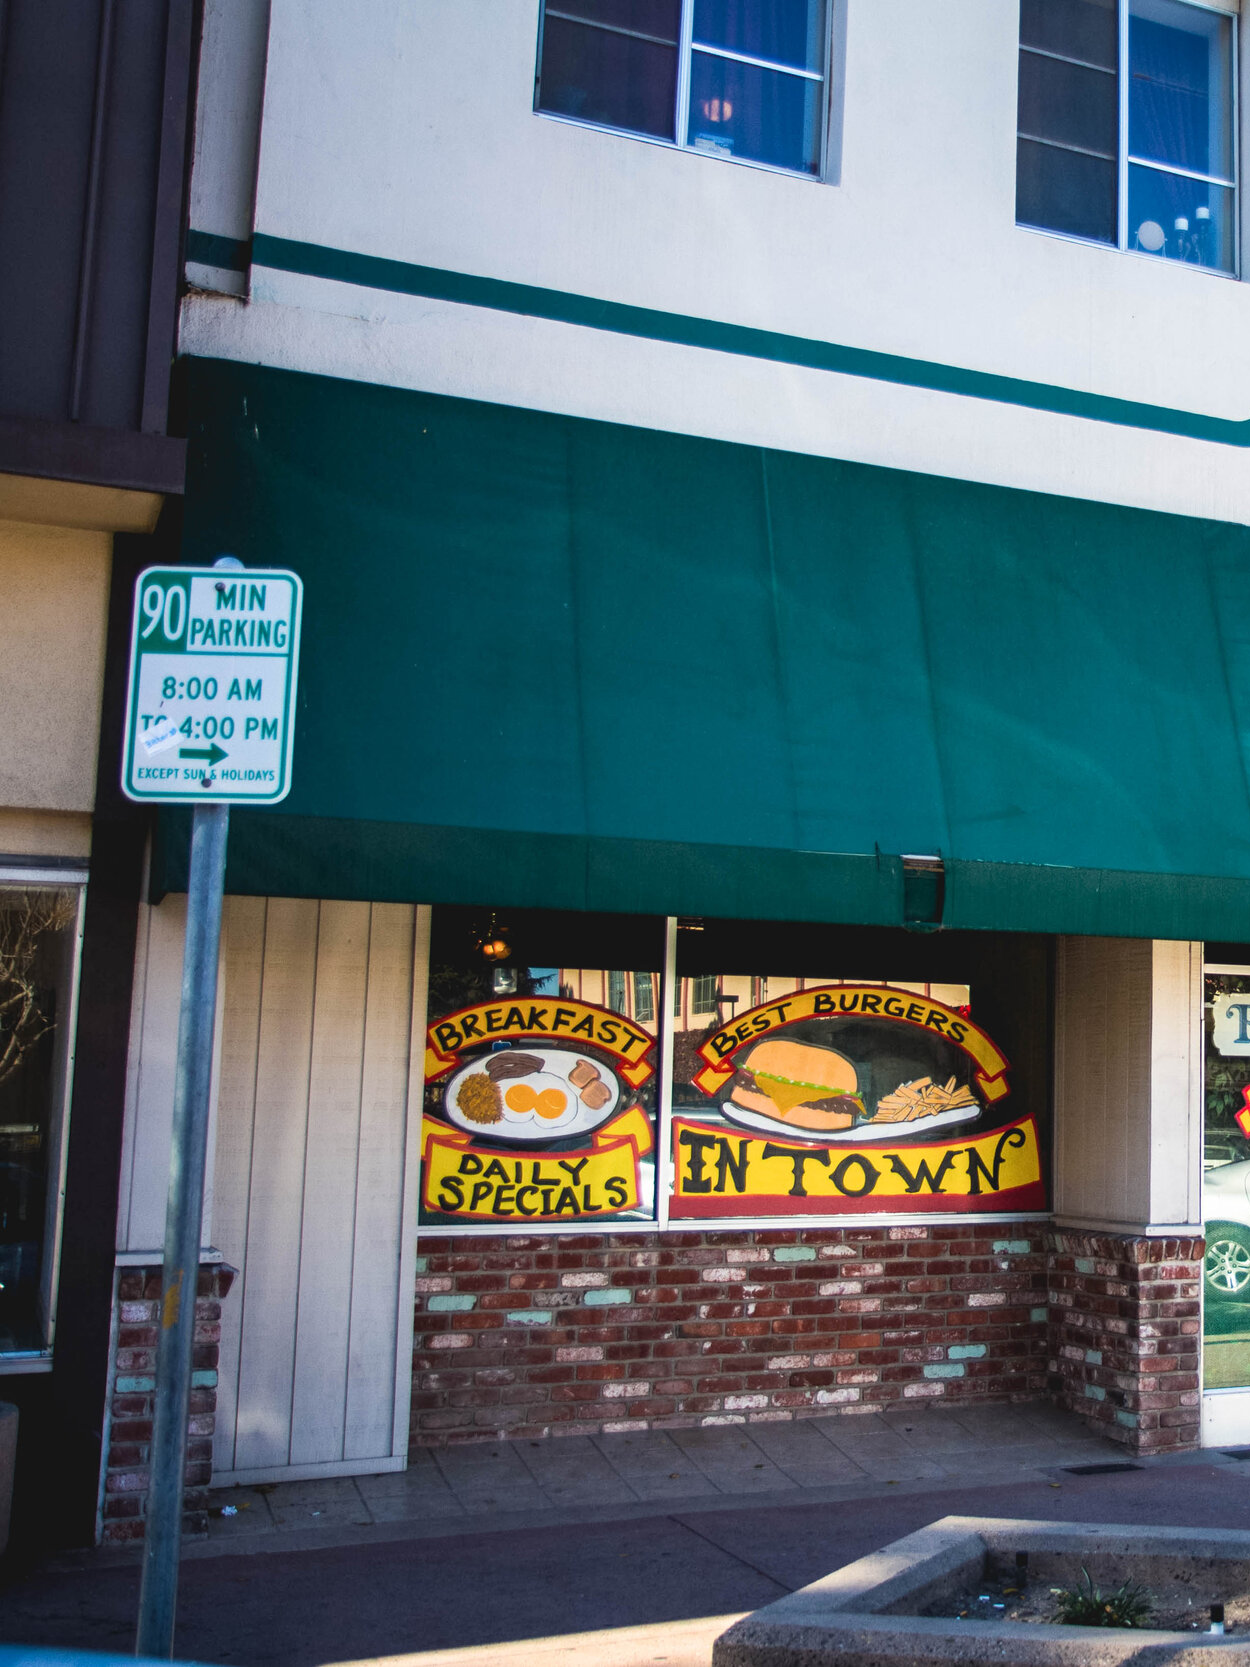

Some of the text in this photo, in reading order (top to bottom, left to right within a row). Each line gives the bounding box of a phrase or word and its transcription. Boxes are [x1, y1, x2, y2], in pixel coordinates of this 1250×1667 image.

[141, 584, 267, 641] 90 MIN
[190, 618, 287, 648] PARKING
[162, 676, 263, 701] 8:00 AM
[179, 716, 235, 740] 4:00
[245, 717, 278, 741] PM
[137, 768, 275, 782] EXCEPT SUN & HOLIDAYS
[434, 1006, 648, 1054] BREAKFAST
[711, 993, 969, 1058] BEST BURGERS
[458, 1153, 588, 1187] DAILY
[679, 1128, 1026, 1197] IN TOWN
[438, 1175, 629, 1216] SPECIALS
